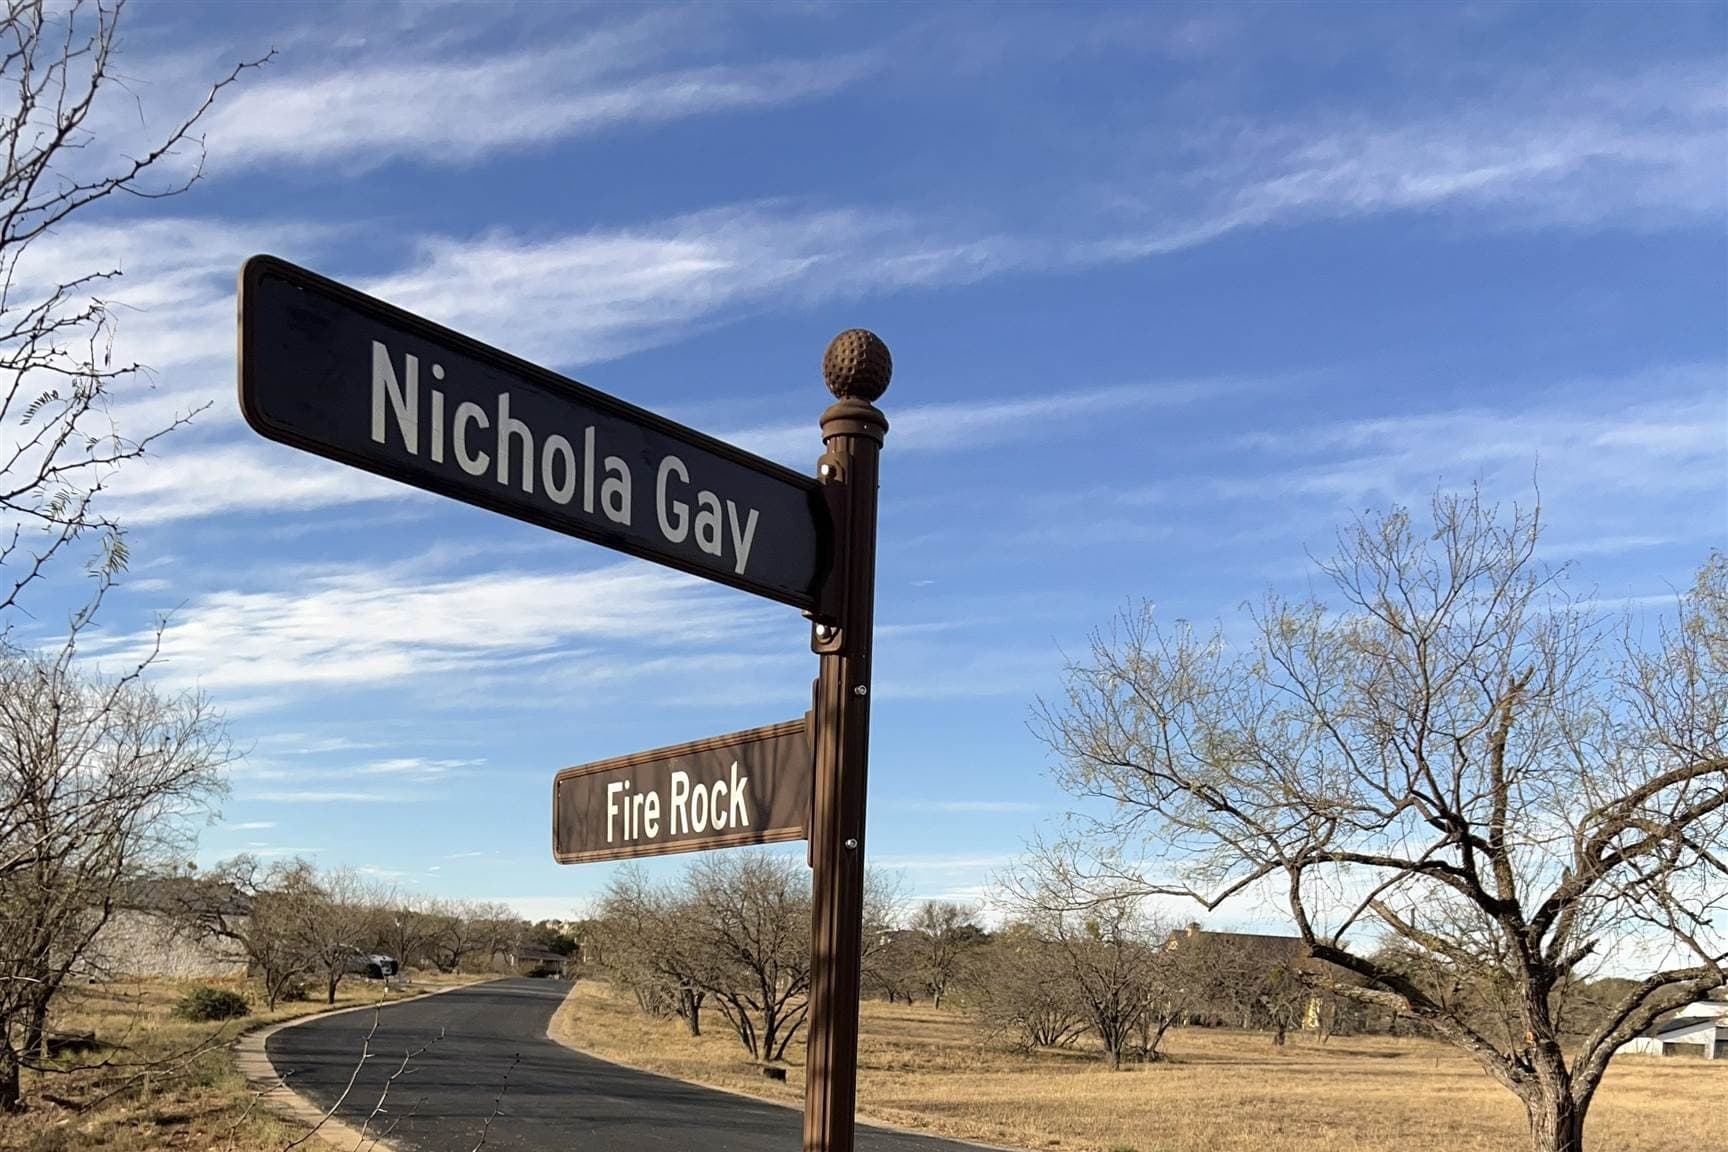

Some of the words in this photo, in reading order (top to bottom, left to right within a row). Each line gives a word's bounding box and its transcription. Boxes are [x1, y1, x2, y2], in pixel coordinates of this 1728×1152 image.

[371, 340, 632, 526] Nichola
[656, 455, 760, 575] Gay
[606, 781, 661, 843] Fire
[669, 760, 750, 836] Rock
